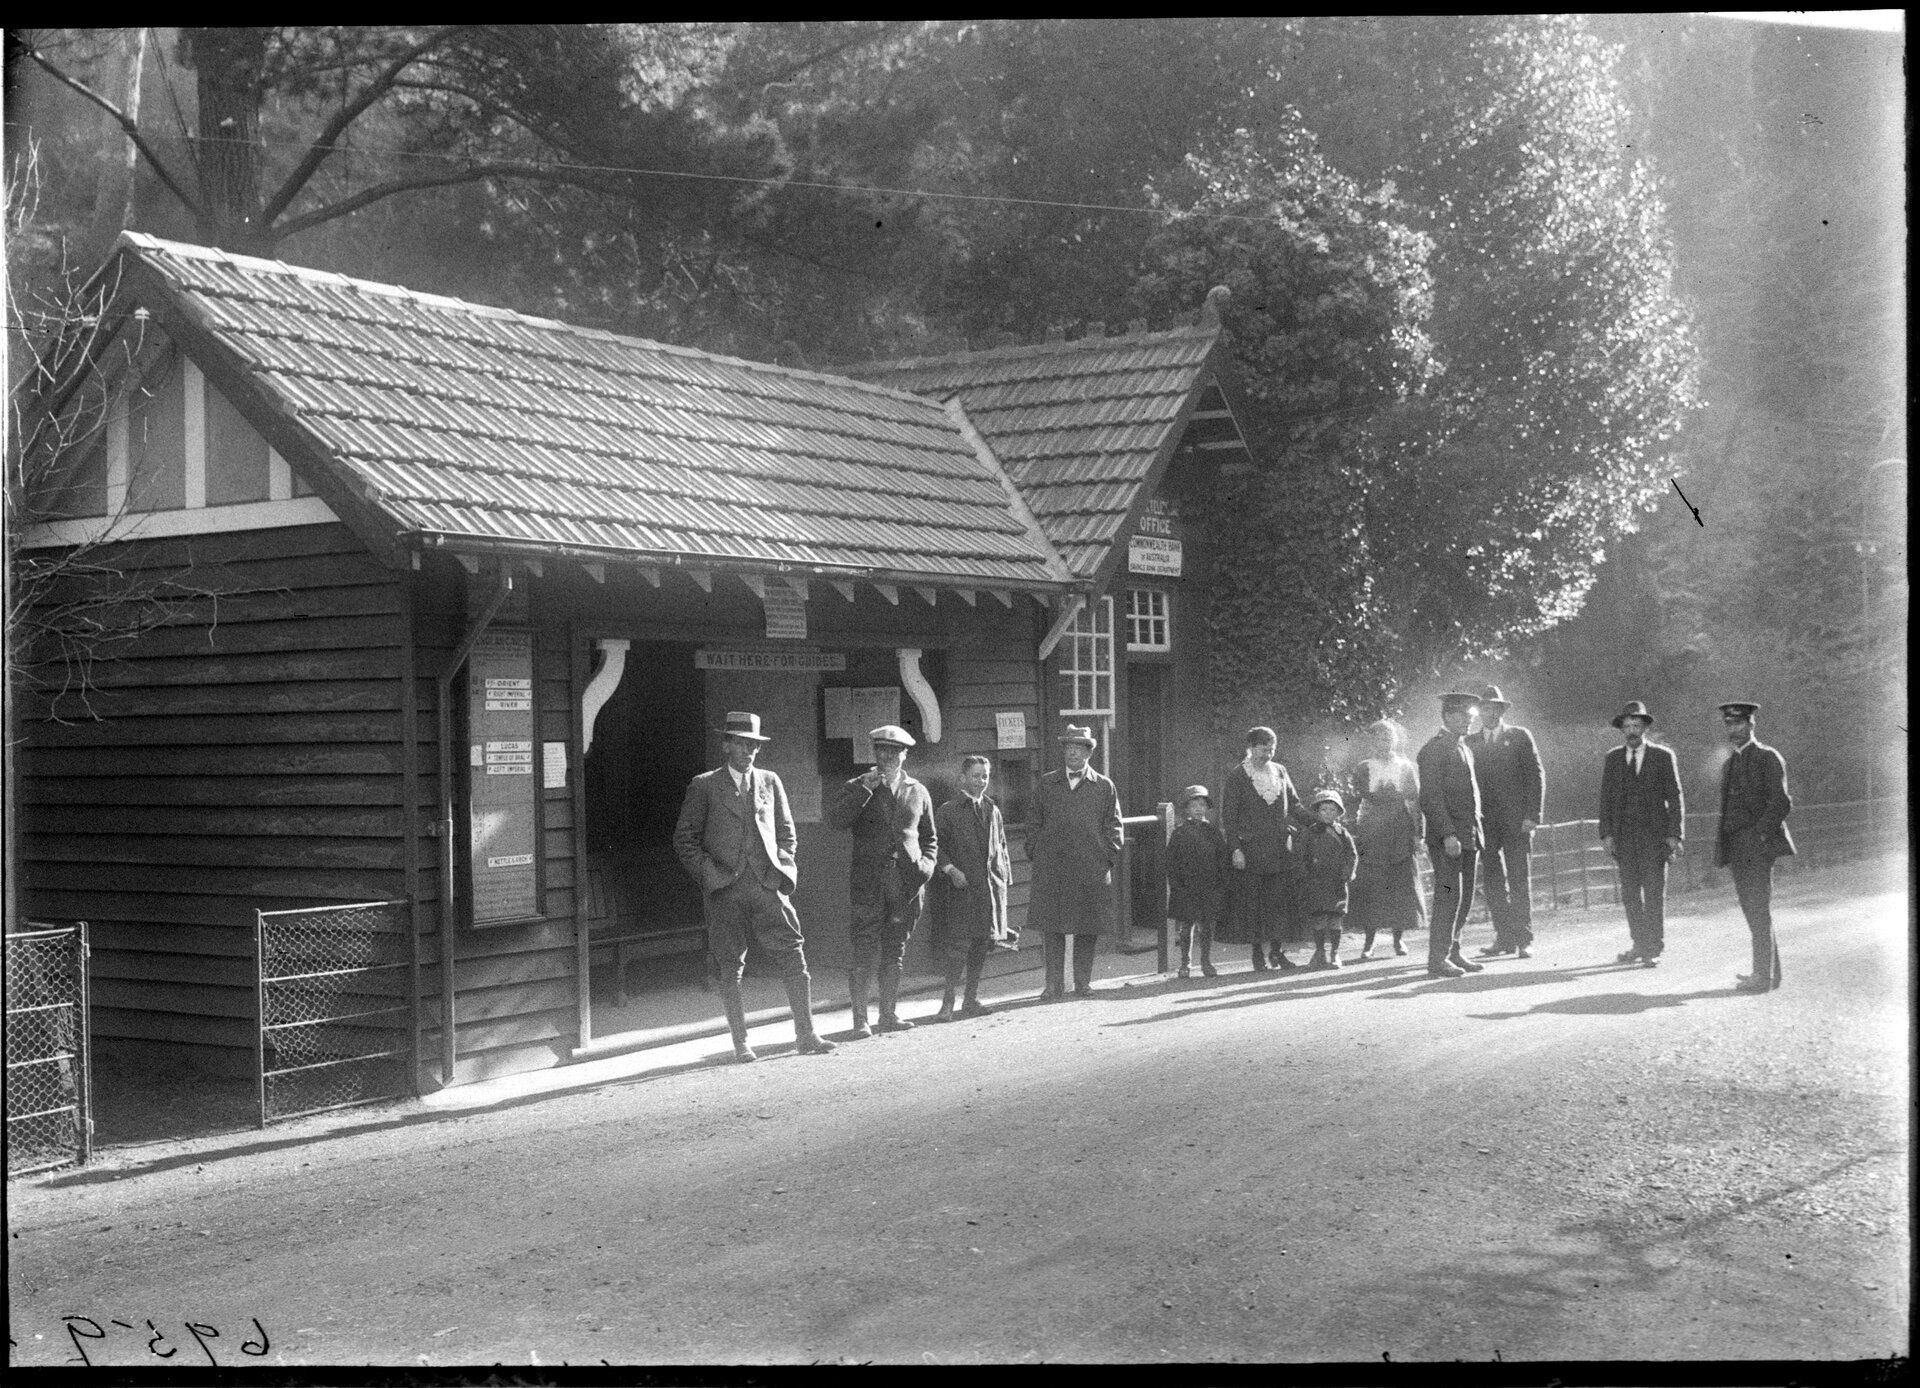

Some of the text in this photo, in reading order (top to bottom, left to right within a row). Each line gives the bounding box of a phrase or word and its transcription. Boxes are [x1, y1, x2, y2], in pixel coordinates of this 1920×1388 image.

[1139, 516, 1172, 534] OFFICE
[706, 653, 735, 666] WAIT
[738, 654, 771, 667] HERE
[773, 655, 795, 667] FOR
